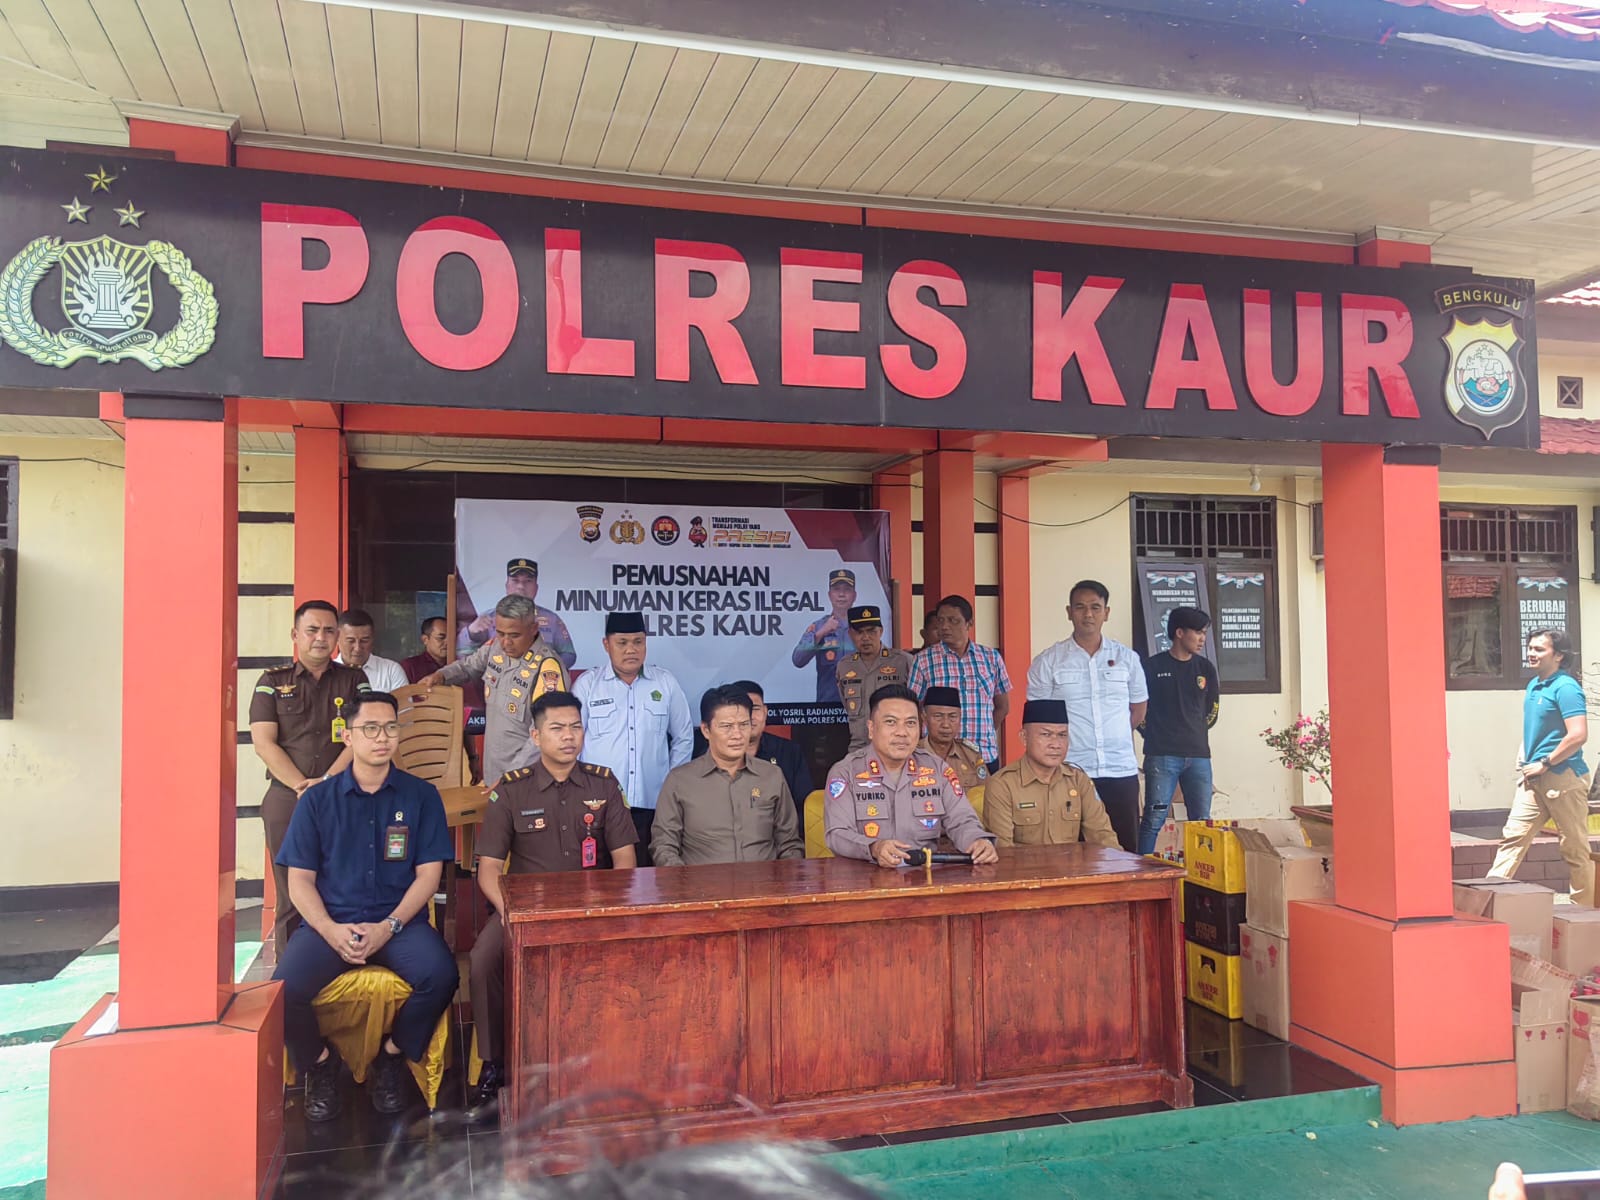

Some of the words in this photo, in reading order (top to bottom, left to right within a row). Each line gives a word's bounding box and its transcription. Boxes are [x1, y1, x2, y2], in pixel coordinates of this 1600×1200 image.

[1443, 289, 1521, 311] BENGKULU
[261, 202, 967, 399] POLRES
[1032, 270, 1420, 419] KAUR
[714, 529, 791, 543] PRESISI
[612, 564, 770, 586] PEMUSNAHAN
[555, 589, 673, 611] MINUMAN
[678, 590, 751, 612] KERAS
[755, 591, 825, 612] ILEGAL
[1519, 600, 1566, 613] BERUBAH
[605, 613, 705, 636] LRES
[713, 614, 784, 636] KAUR
[779, 709, 805, 717] YOSRIL
[806, 708, 848, 716] RADIANSYA
[467, 716, 486, 725] AKB
[783, 717, 806, 725] WAKA
[808, 717, 835, 725] POLRES
[836, 716, 849, 724] KA
[856, 792, 886, 801] YURIKO
[911, 788, 940, 798] POLRI
[1194, 861, 1216, 874] ANKER
